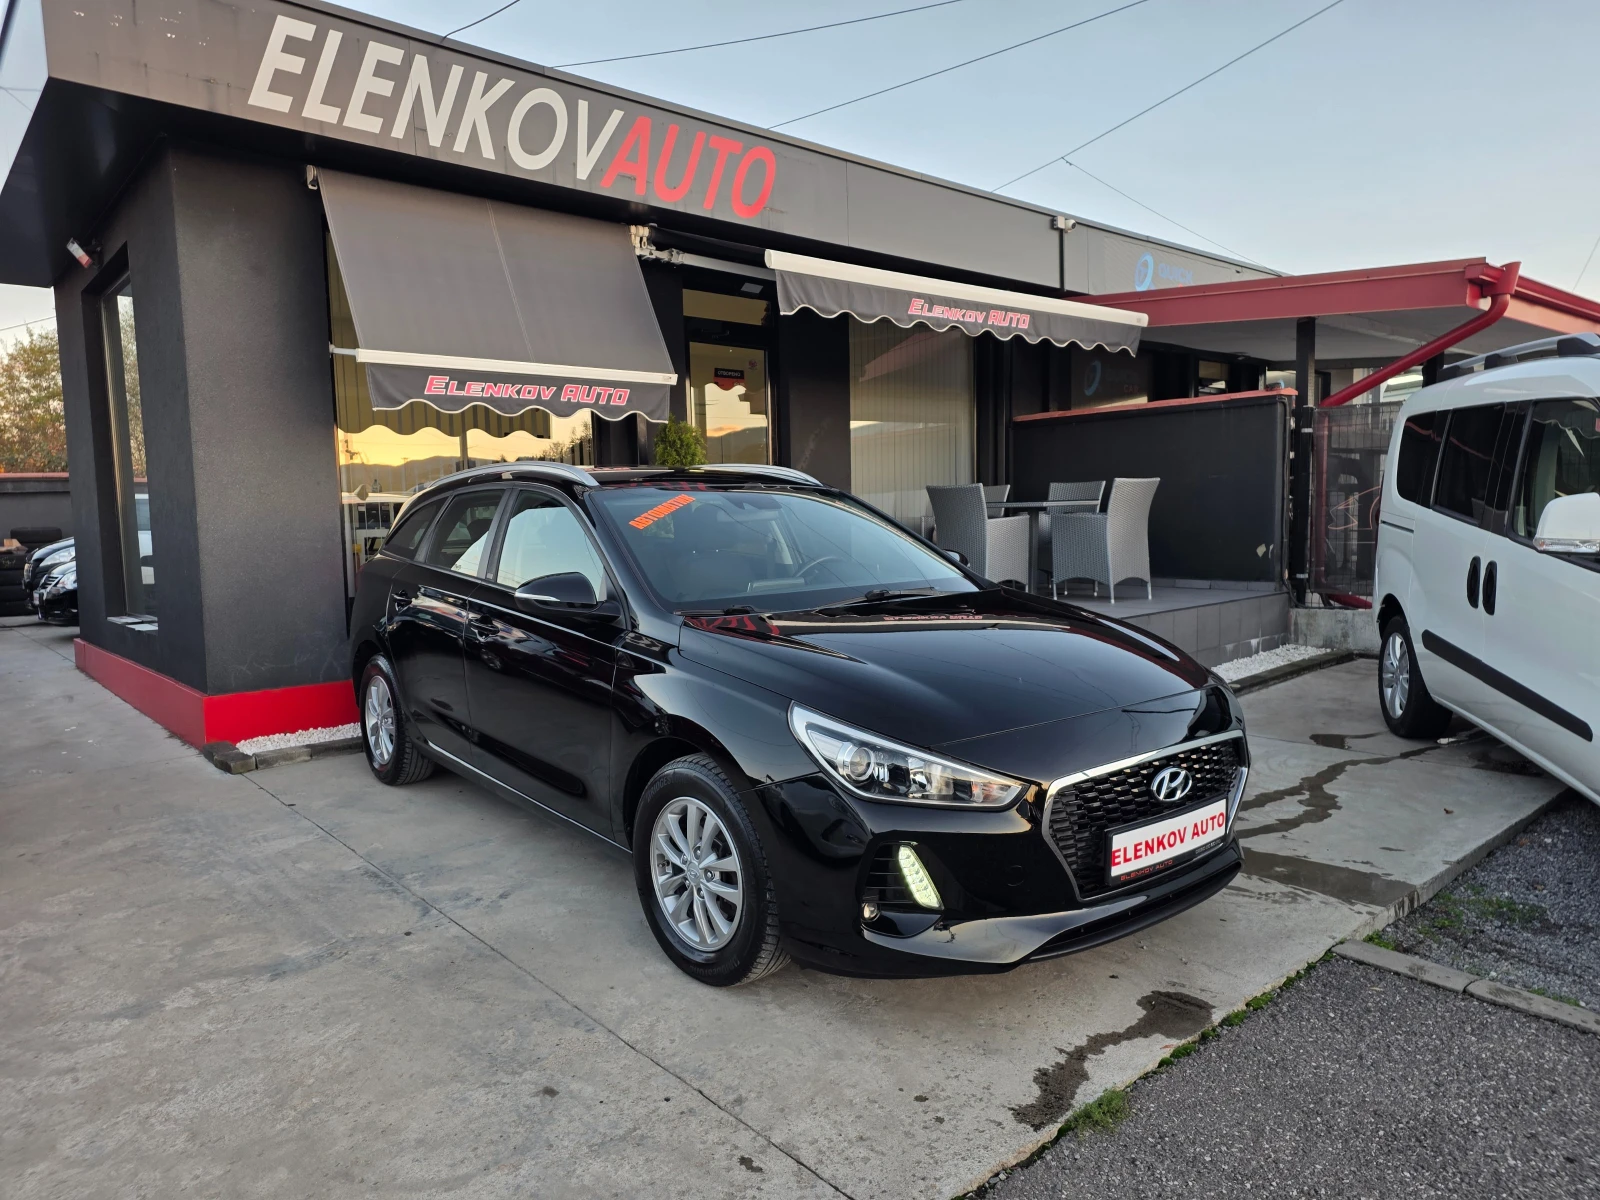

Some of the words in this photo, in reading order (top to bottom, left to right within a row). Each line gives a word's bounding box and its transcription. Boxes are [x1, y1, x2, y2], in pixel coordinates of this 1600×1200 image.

[908, 298, 986, 323] ELENKOV
[988, 309, 1030, 329] AUTO
[424, 375, 557, 400] ELENKOV
[561, 384, 630, 406] AUTO
[1111, 826, 1187, 867] ELENKOV
[1191, 812, 1225, 840] AUTO
[1155, 859, 1173, 870] AUTO
